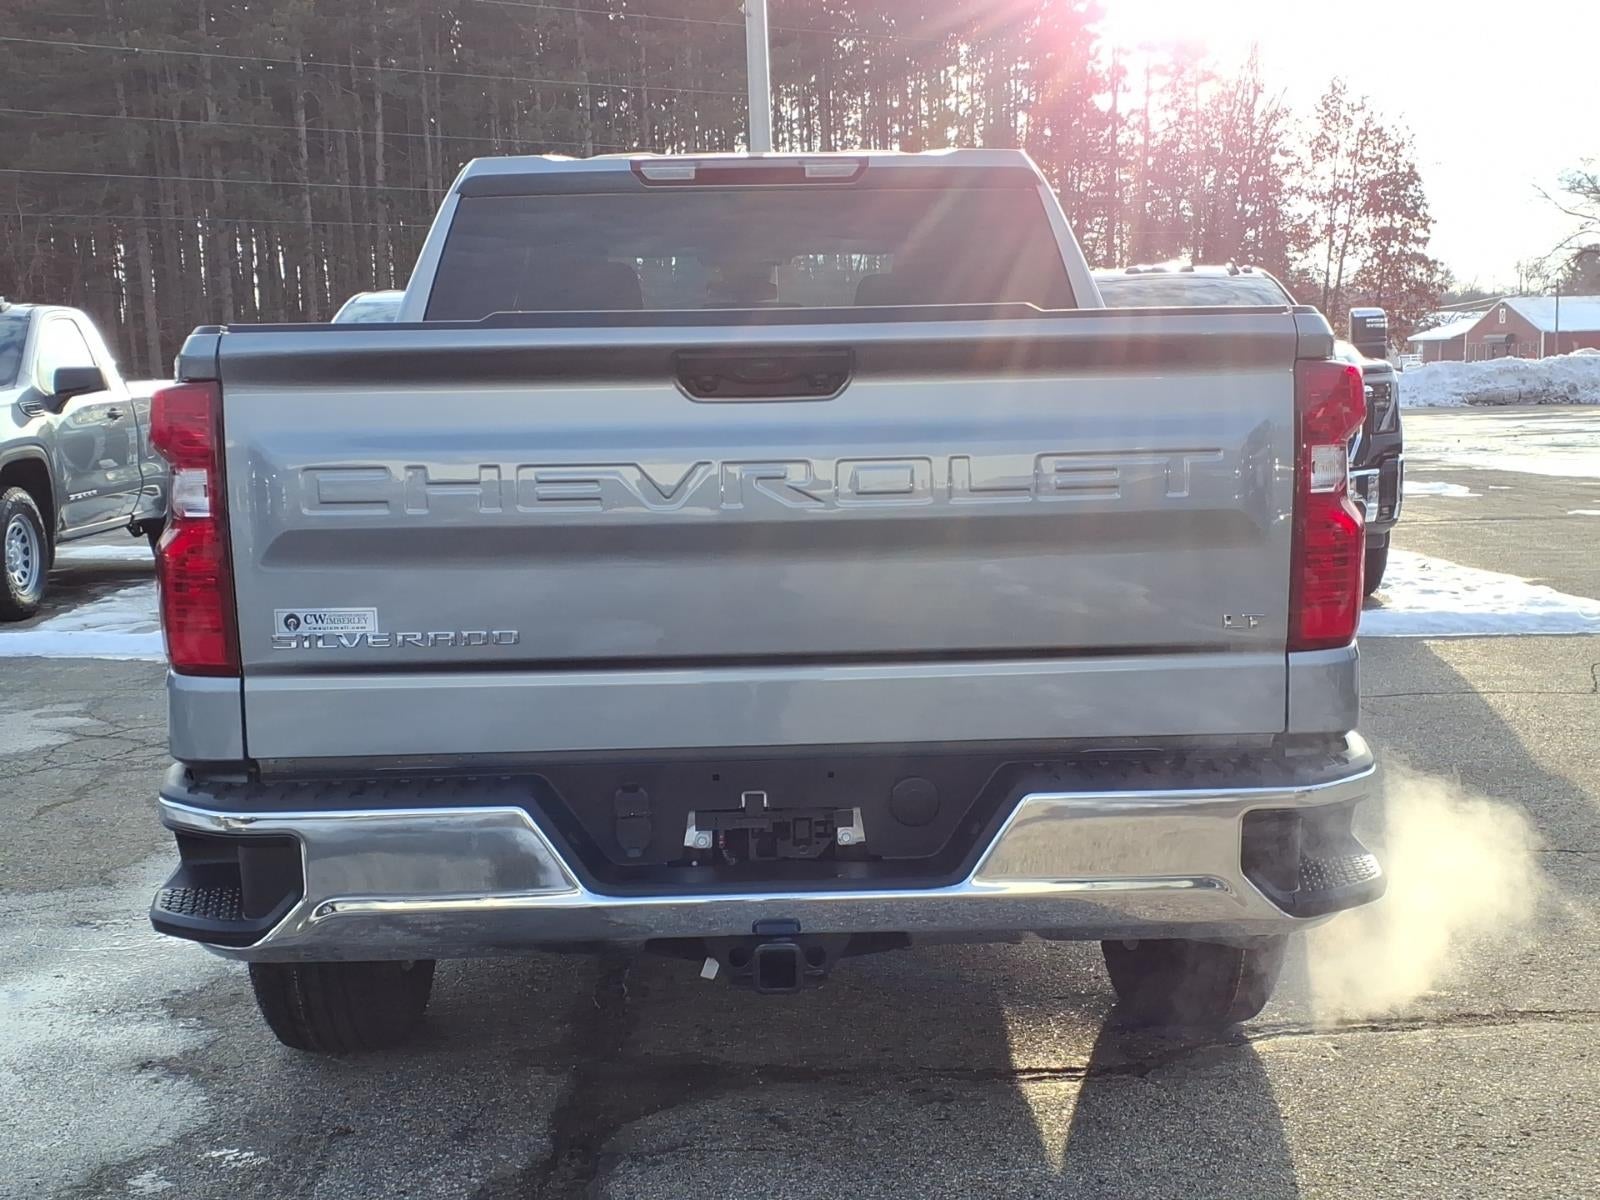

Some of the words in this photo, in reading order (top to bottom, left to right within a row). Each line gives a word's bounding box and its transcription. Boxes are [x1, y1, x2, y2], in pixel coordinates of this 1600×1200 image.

[300, 447, 1224, 515] CHEVROLET
[1222, 612, 1265, 629] LT
[271, 630, 520, 649] SILVERADO
